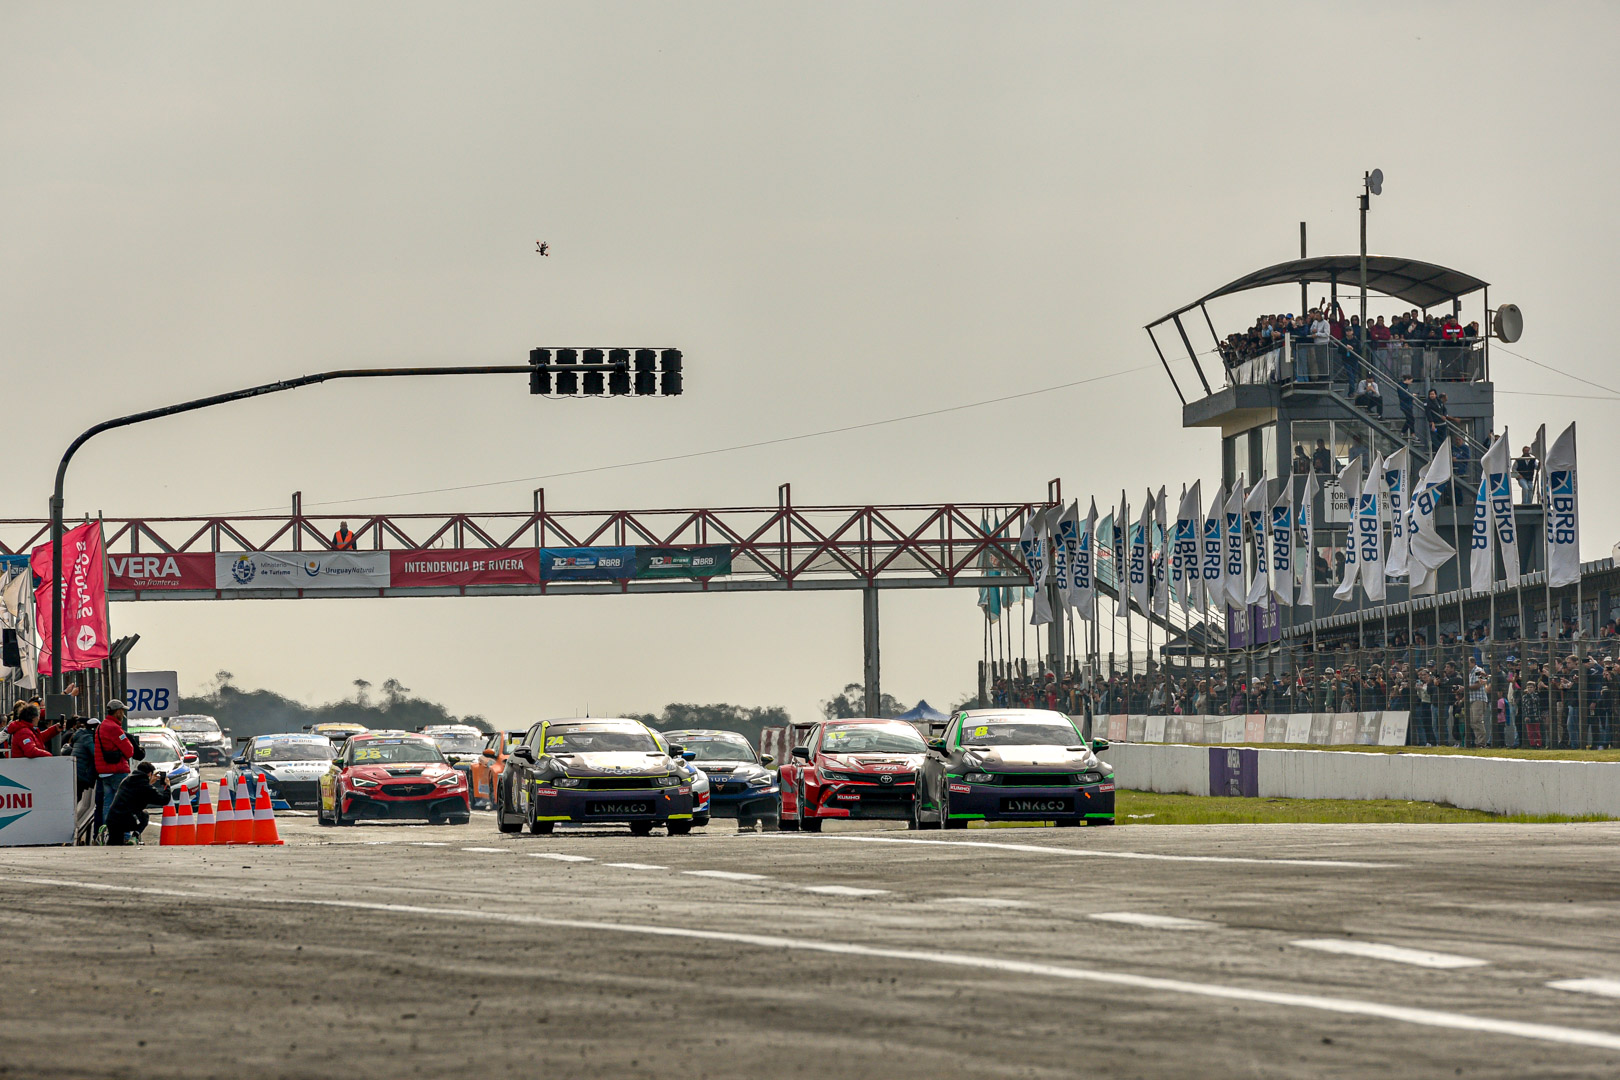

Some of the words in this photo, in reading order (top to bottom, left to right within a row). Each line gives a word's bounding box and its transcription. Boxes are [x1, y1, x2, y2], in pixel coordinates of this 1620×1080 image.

[1360, 518, 1378, 562] BRB
[1553, 497, 1575, 545] BRB
[404, 561, 470, 573] INTENDENCIA
[472, 560, 486, 572] DE
[488, 559, 525, 571] RIVERA
[1130, 546, 1144, 584] BRB
[1181, 541, 1200, 580] BRB
[1203, 541, 1221, 580] BRB
[1228, 535, 1242, 576] BRB
[1273, 529, 1289, 571] BRB
[146, 579, 180, 587] fronteras
[1074, 551, 1090, 589] BRB
[126, 687, 170, 712] BRB
[547, 735, 564, 746] 24
[974, 726, 989, 737] 8
[355, 750, 382, 761] 28
